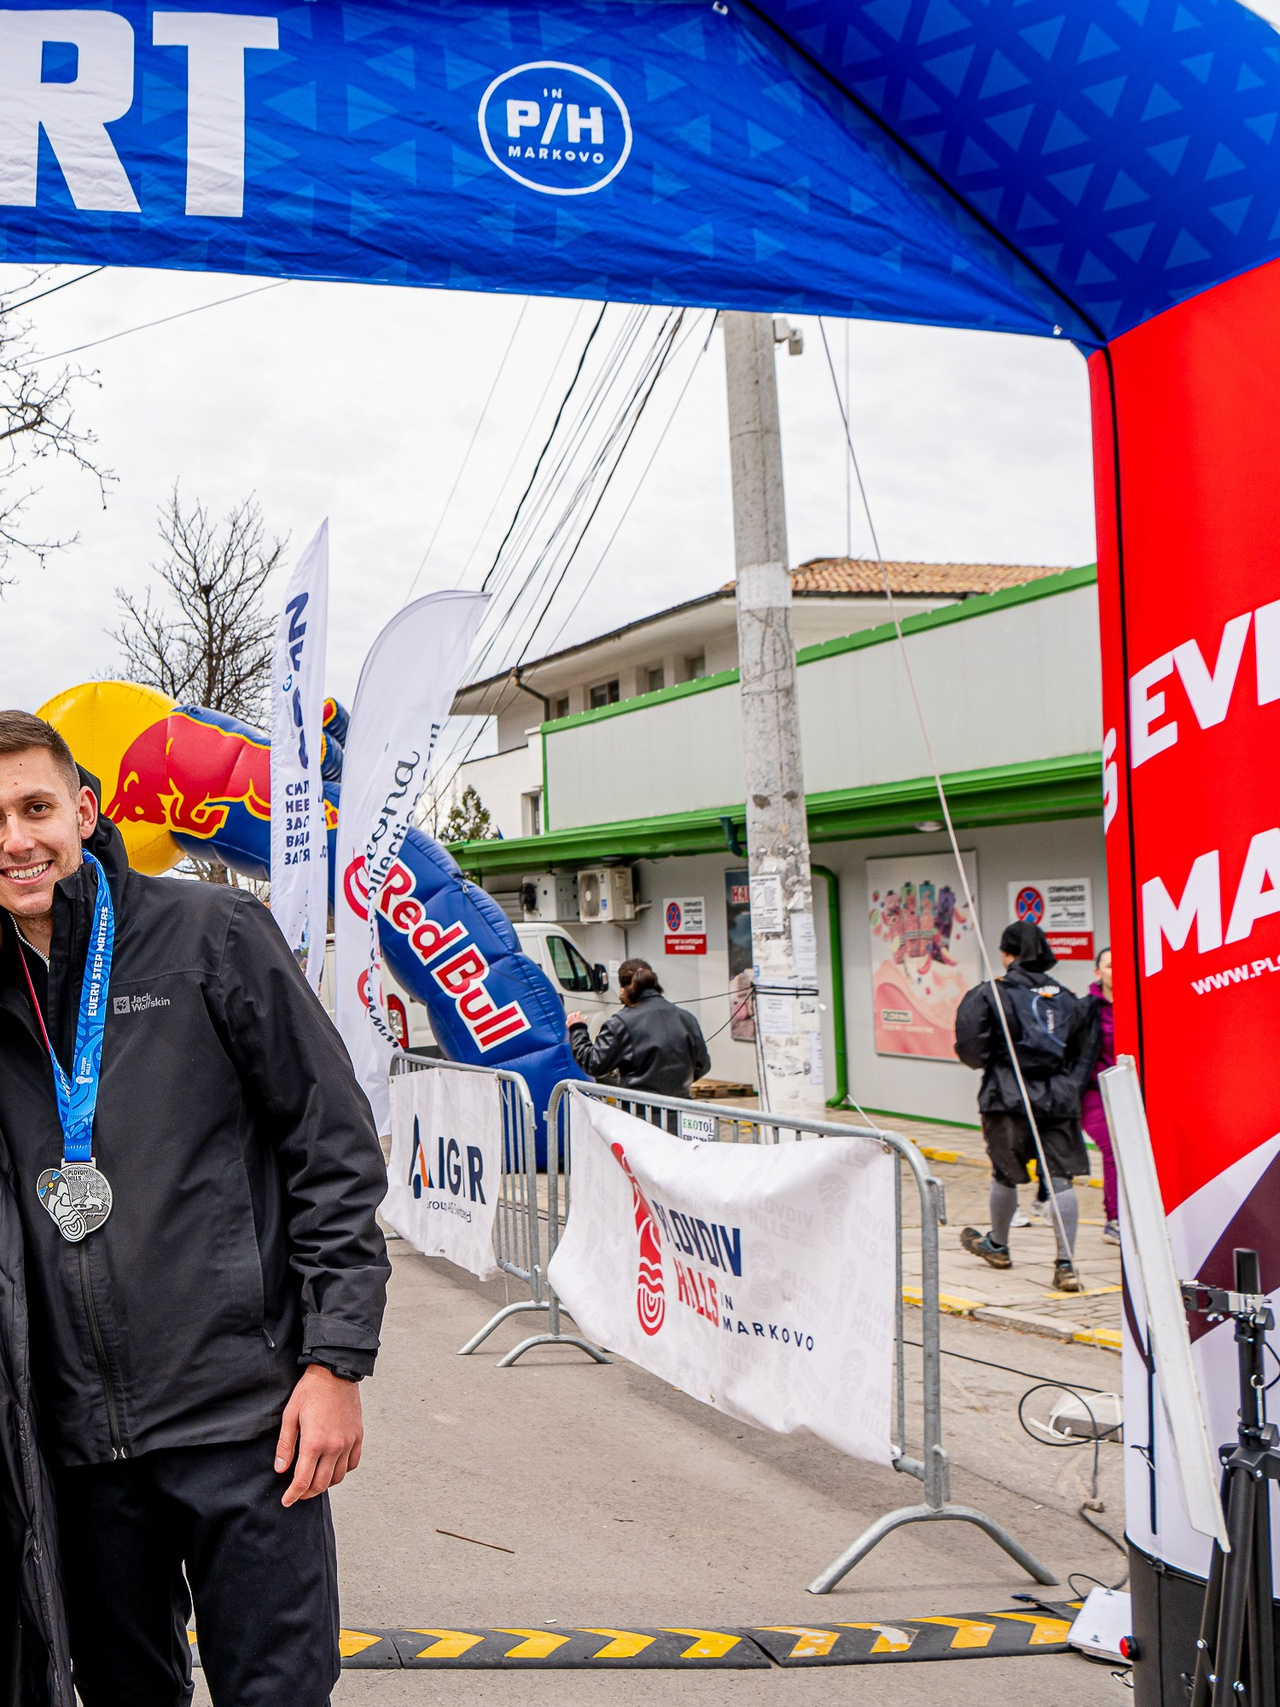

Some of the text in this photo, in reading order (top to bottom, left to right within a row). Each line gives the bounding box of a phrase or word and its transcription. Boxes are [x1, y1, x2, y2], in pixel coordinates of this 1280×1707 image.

[543, 87, 563, 99] IN
[506, 99, 604, 145] P/H
[508, 145, 605, 165] MARKOVO
[87, 906, 109, 1017] EVERY STEP MATTERS
[380, 863, 525, 1047] Red Bull
[1190, 954, 1280, 995] WWW.PL
[131, 993, 151, 1004] Jack
[131, 997, 170, 1012] Wolfskin
[652, 1200, 742, 1277] PLOVDIV
[673, 1258, 719, 1328] HILLS
[722, 1316, 814, 1351] MARKOVO
